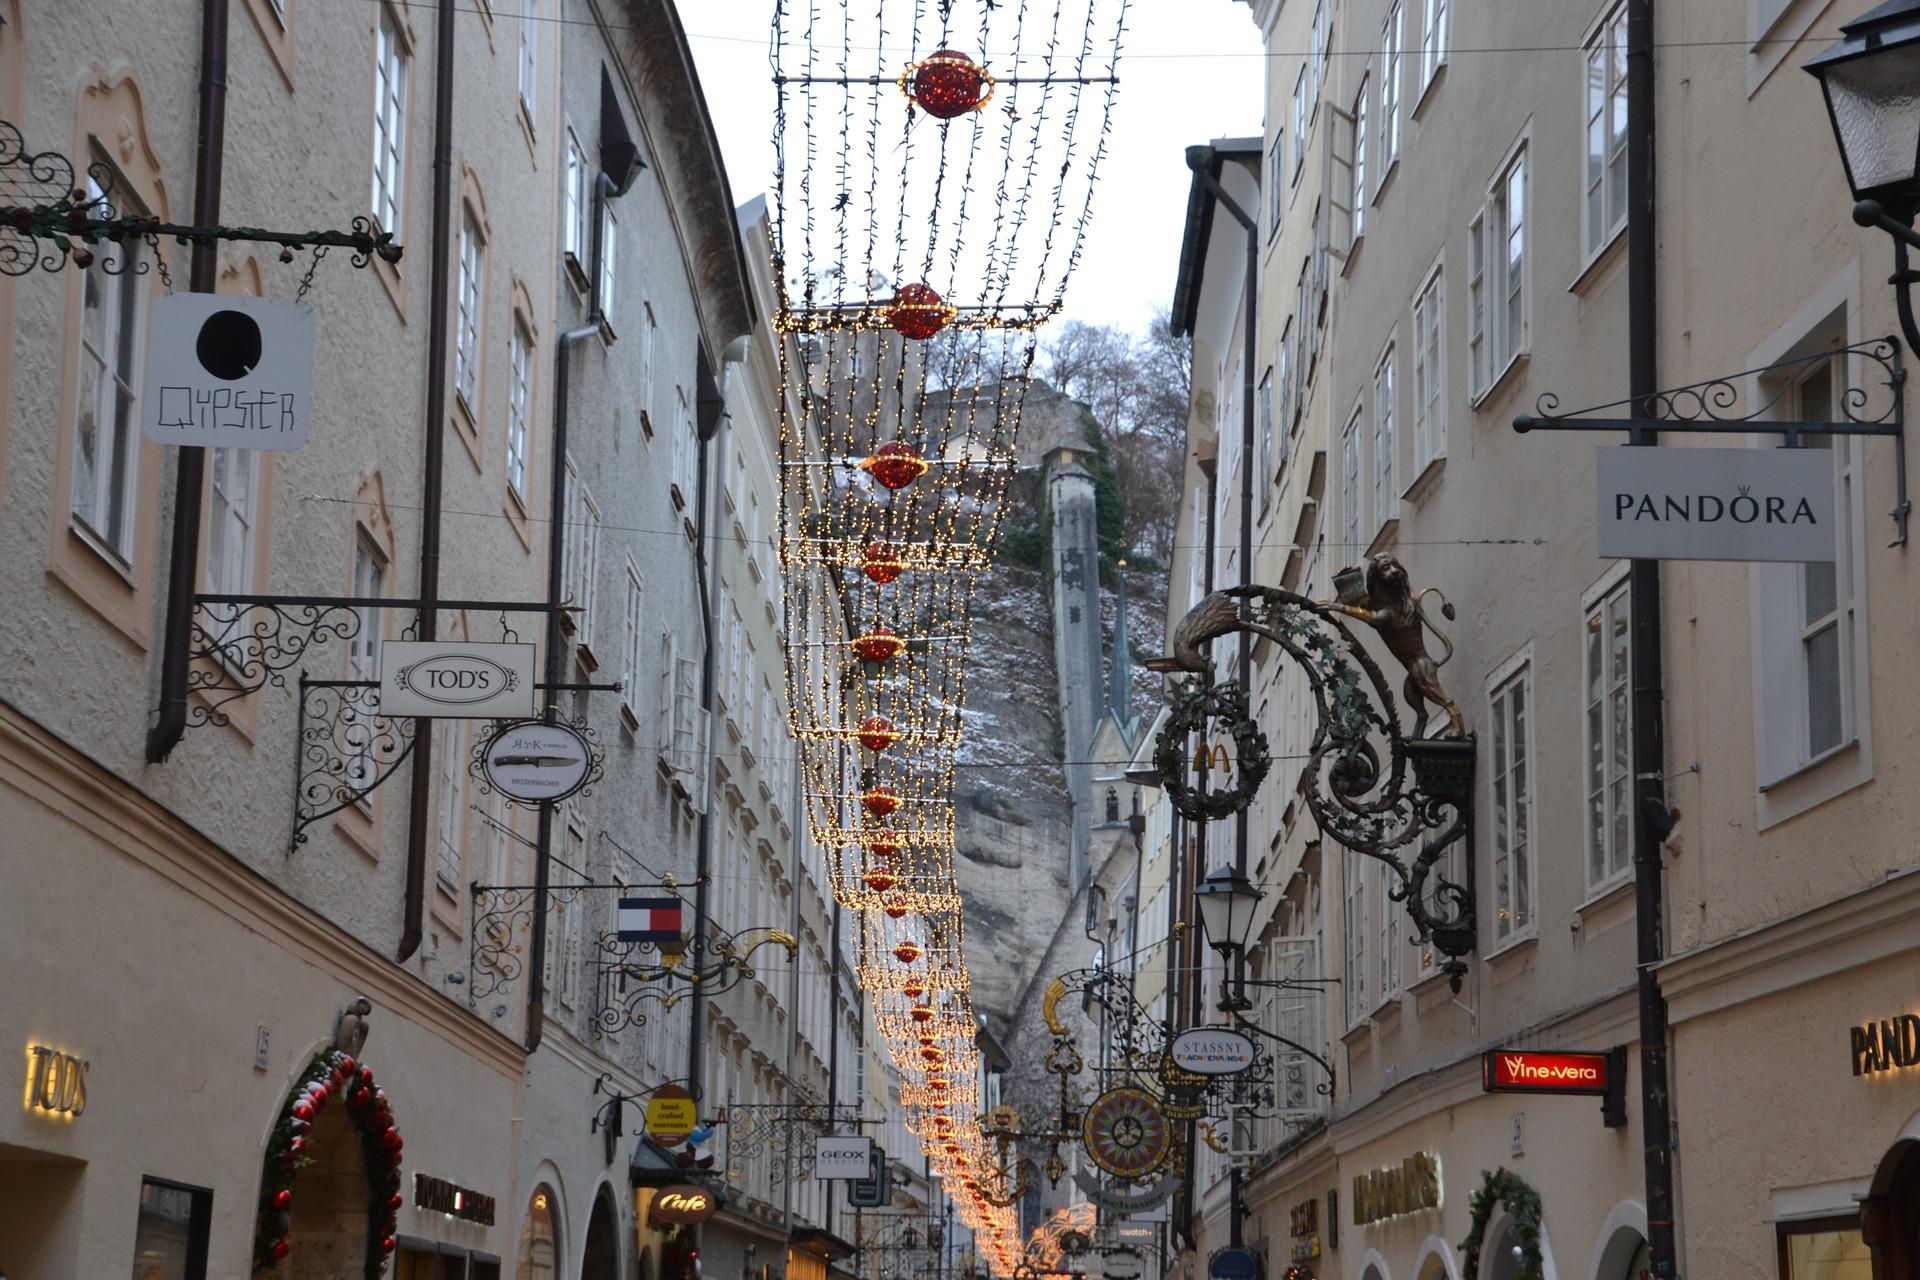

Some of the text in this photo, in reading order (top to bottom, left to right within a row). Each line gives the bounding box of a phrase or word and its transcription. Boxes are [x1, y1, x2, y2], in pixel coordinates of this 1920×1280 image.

[1615, 493, 1817, 525] PANDORA
[426, 669, 490, 689] TOD'S
[1183, 1042, 1242, 1054] STASSNY
[821, 1150, 864, 1159] GEOX
[660, 1193, 706, 1212] Café
